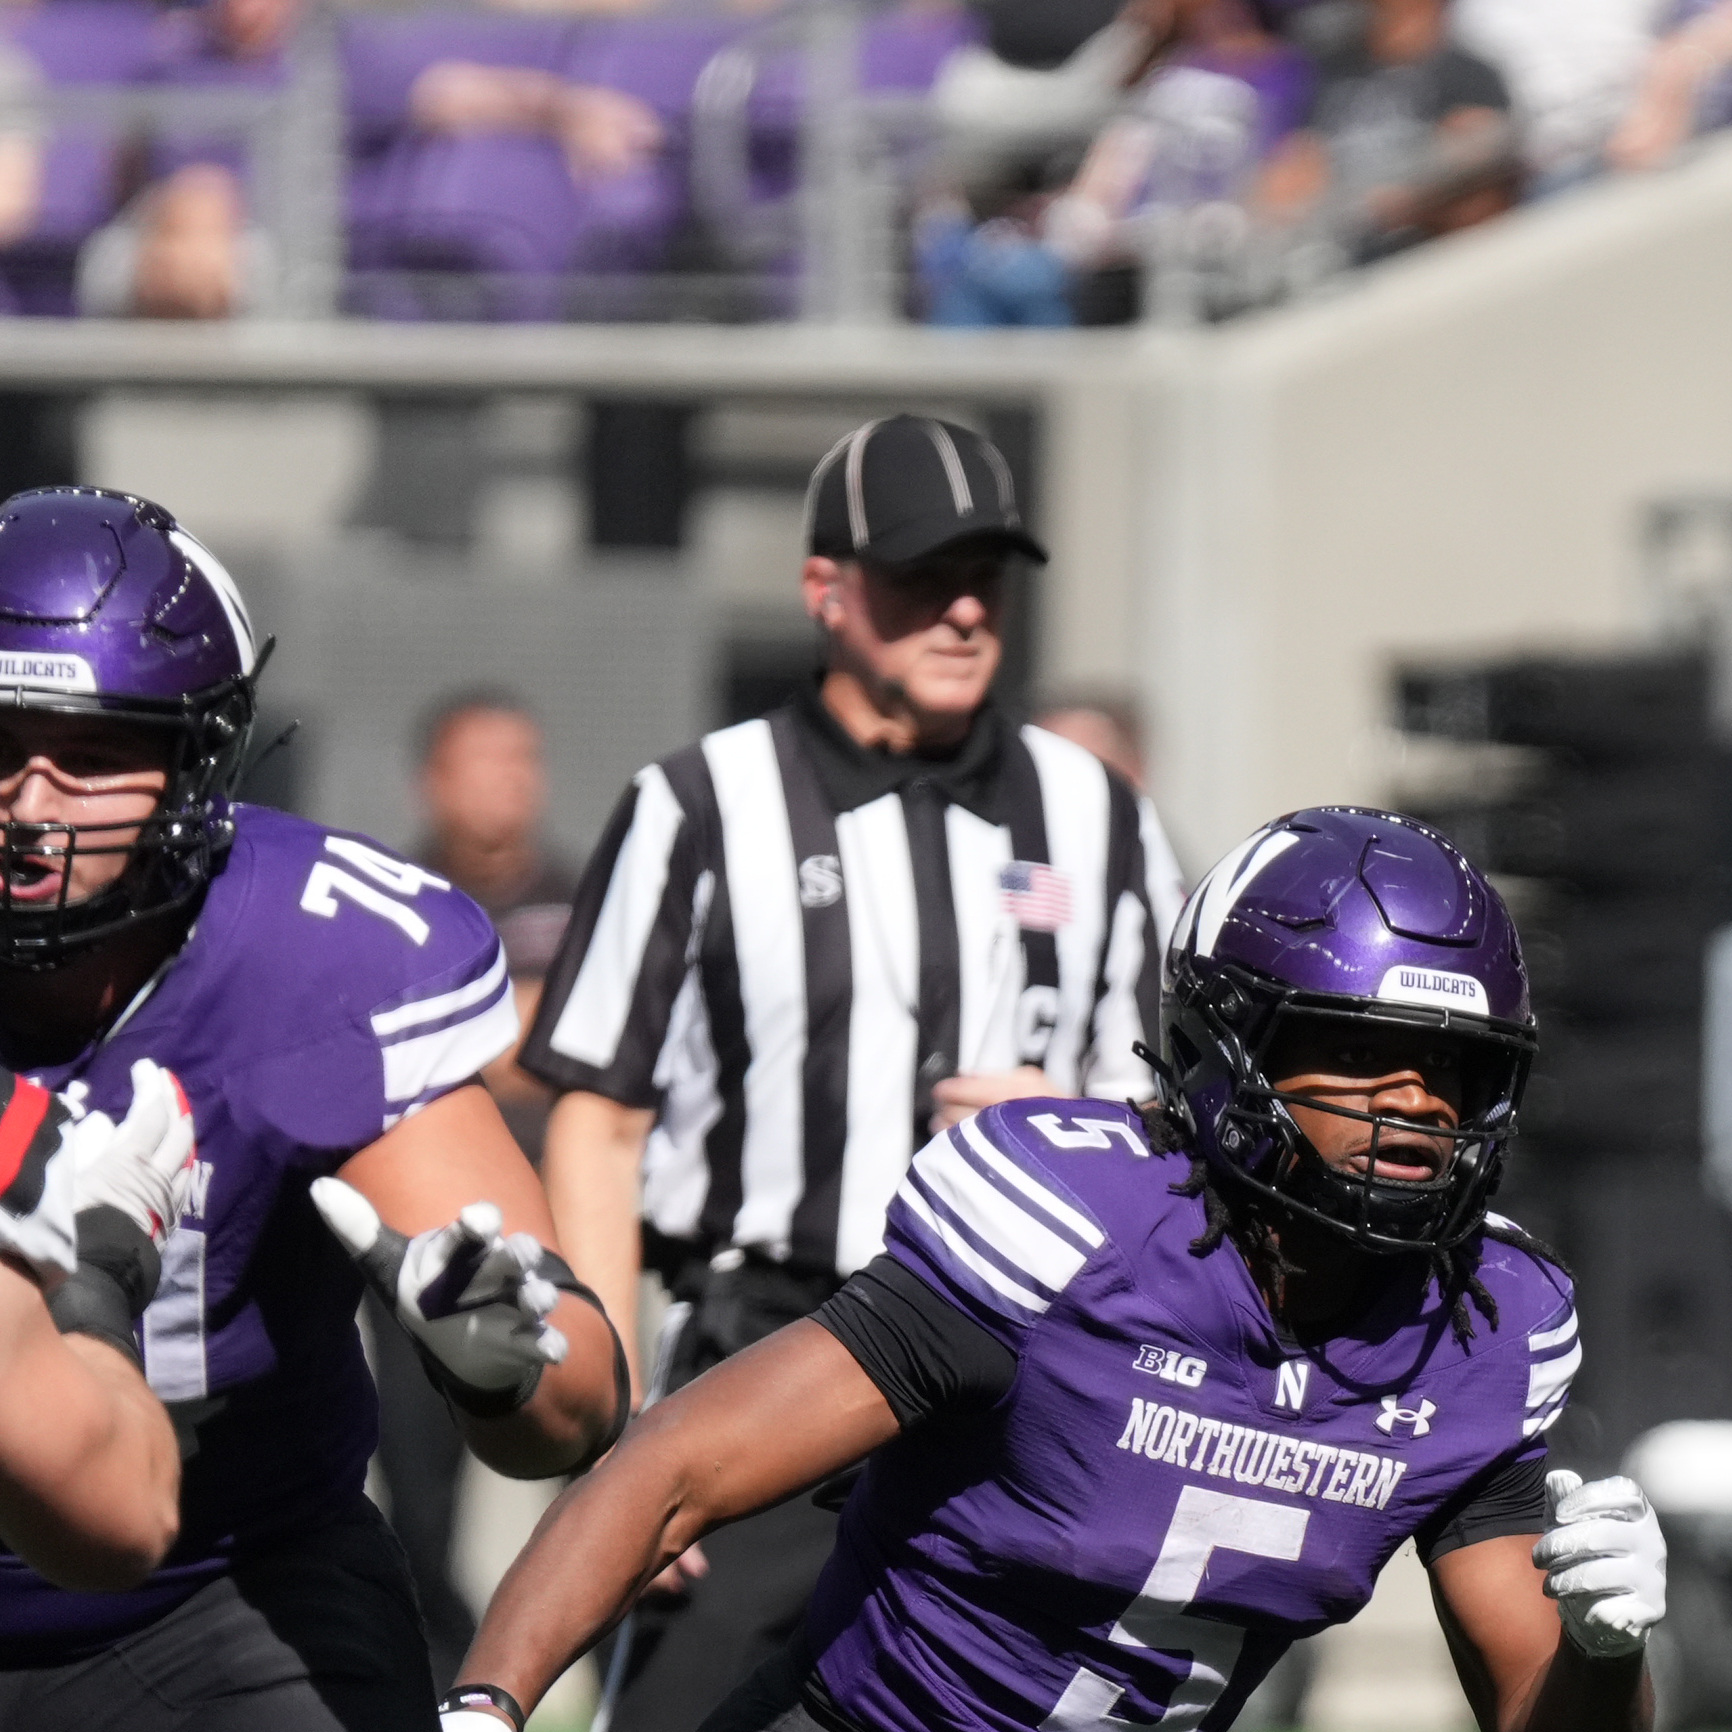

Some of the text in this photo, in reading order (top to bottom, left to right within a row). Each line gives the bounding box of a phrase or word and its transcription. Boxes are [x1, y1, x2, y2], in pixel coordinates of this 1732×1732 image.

[0, 660, 77, 679] ILDCATS
[299, 834, 452, 946] 74
[1399, 970, 1476, 998] WILDCATS
[1030, 1110, 1152, 1160] 5
[1272, 1360, 1311, 1411] N
[1116, 1397, 1408, 1511] NORTHWESTERN
